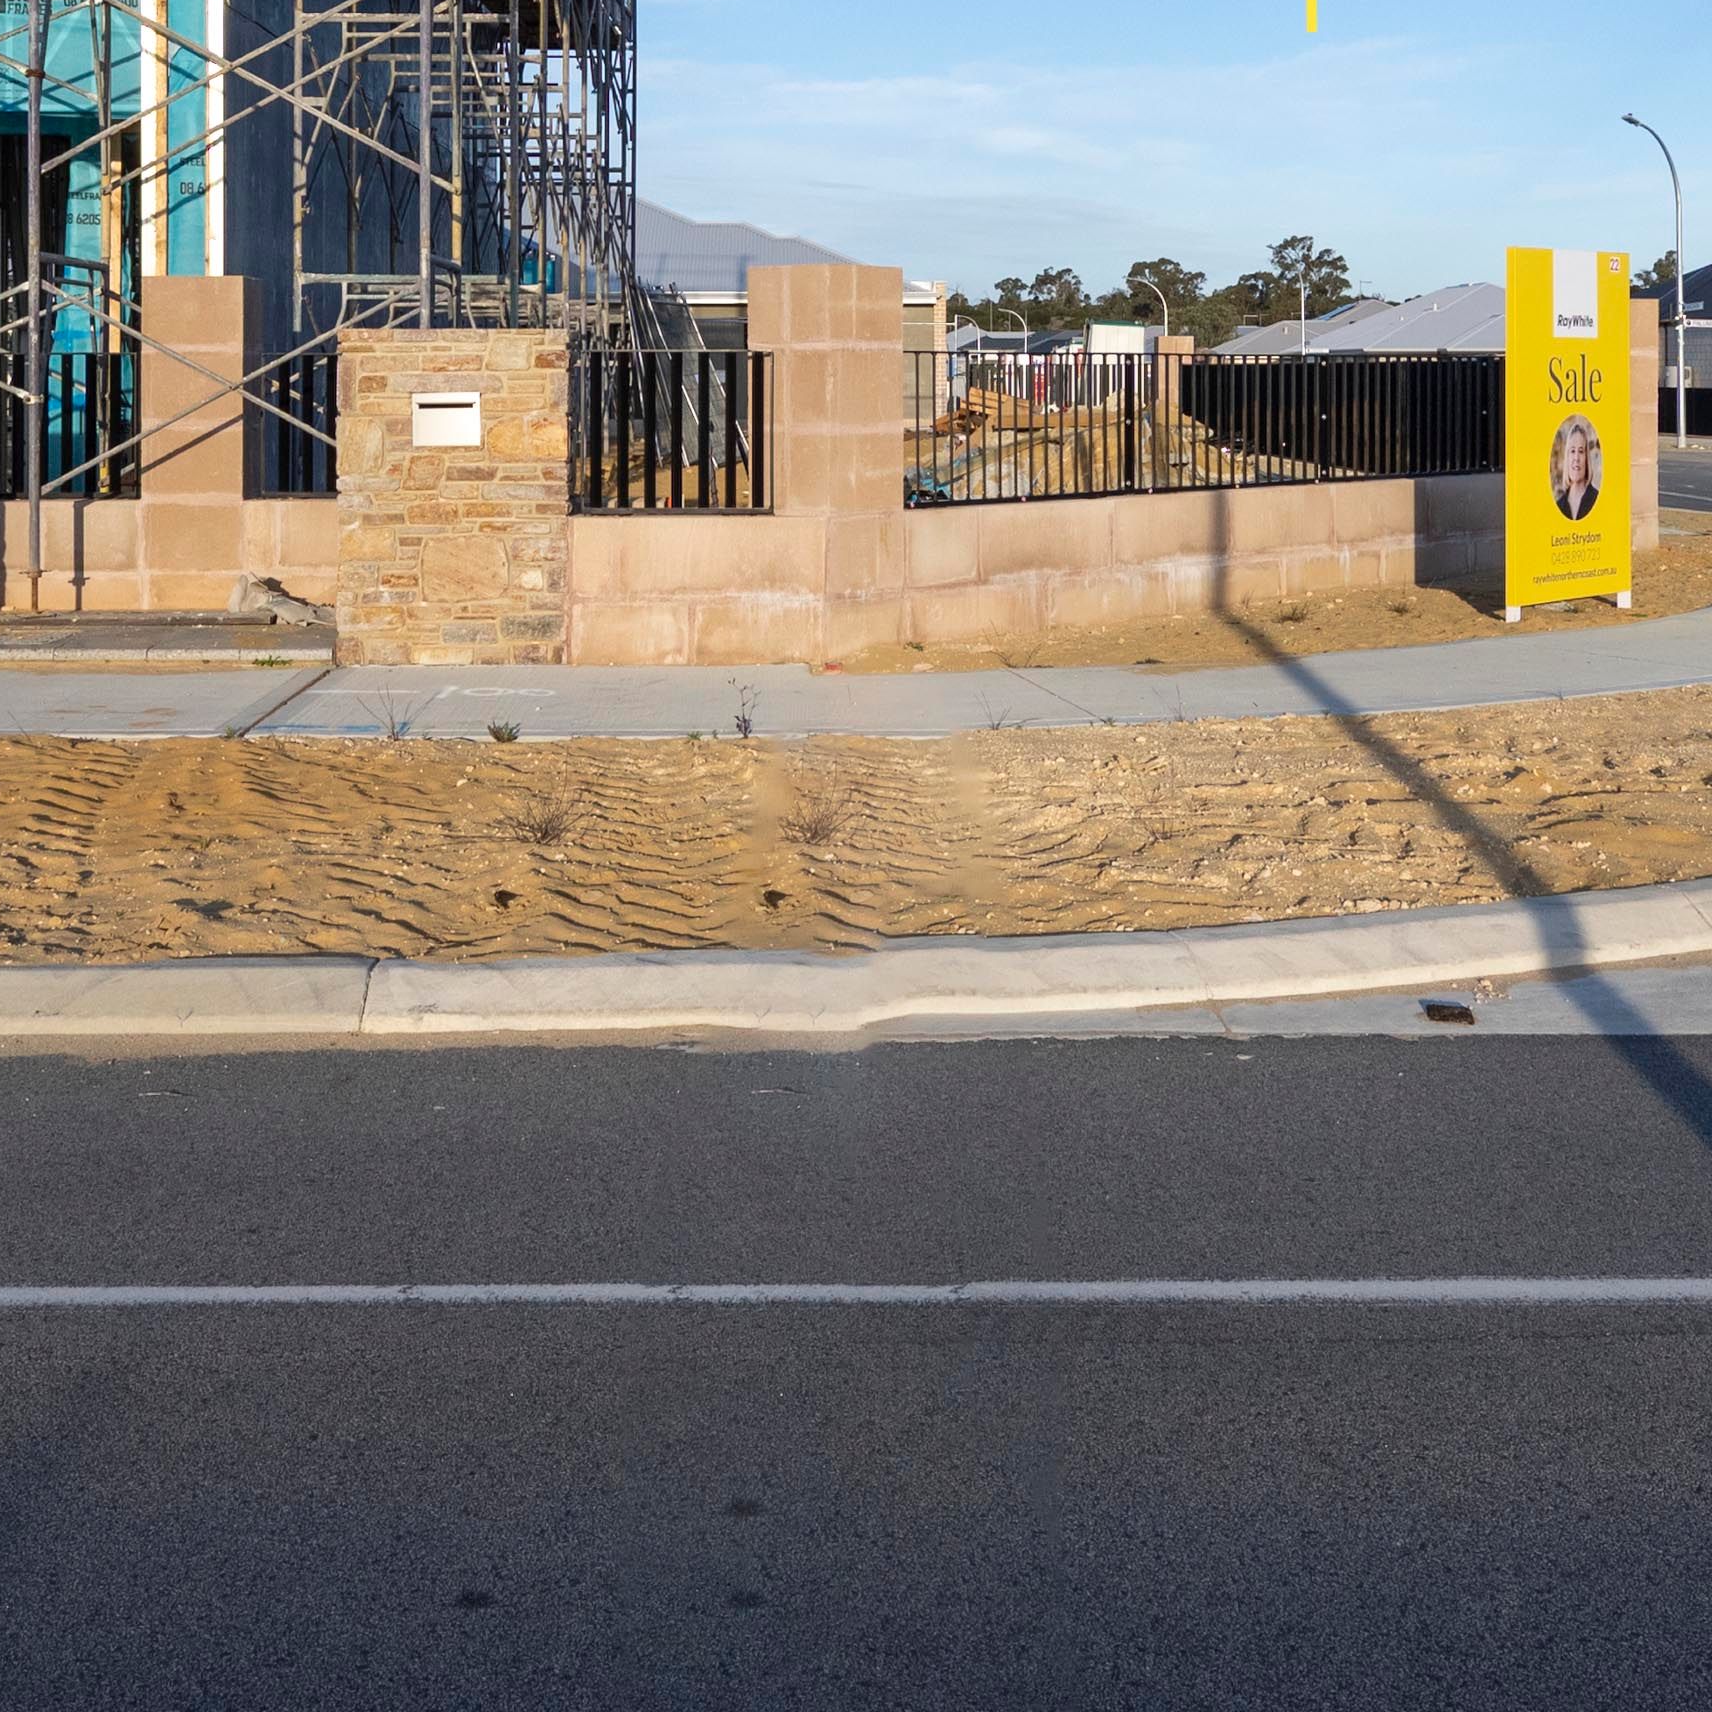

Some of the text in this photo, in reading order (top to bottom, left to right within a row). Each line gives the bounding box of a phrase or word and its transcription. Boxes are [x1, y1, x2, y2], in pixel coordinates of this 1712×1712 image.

[180, 181, 194, 195] 08
[76, 213, 101, 225] 6205
[1609, 258, 1620, 271] 22
[1548, 353, 1602, 404] Sale
[1551, 532, 1602, 547] Leoni Strydom
